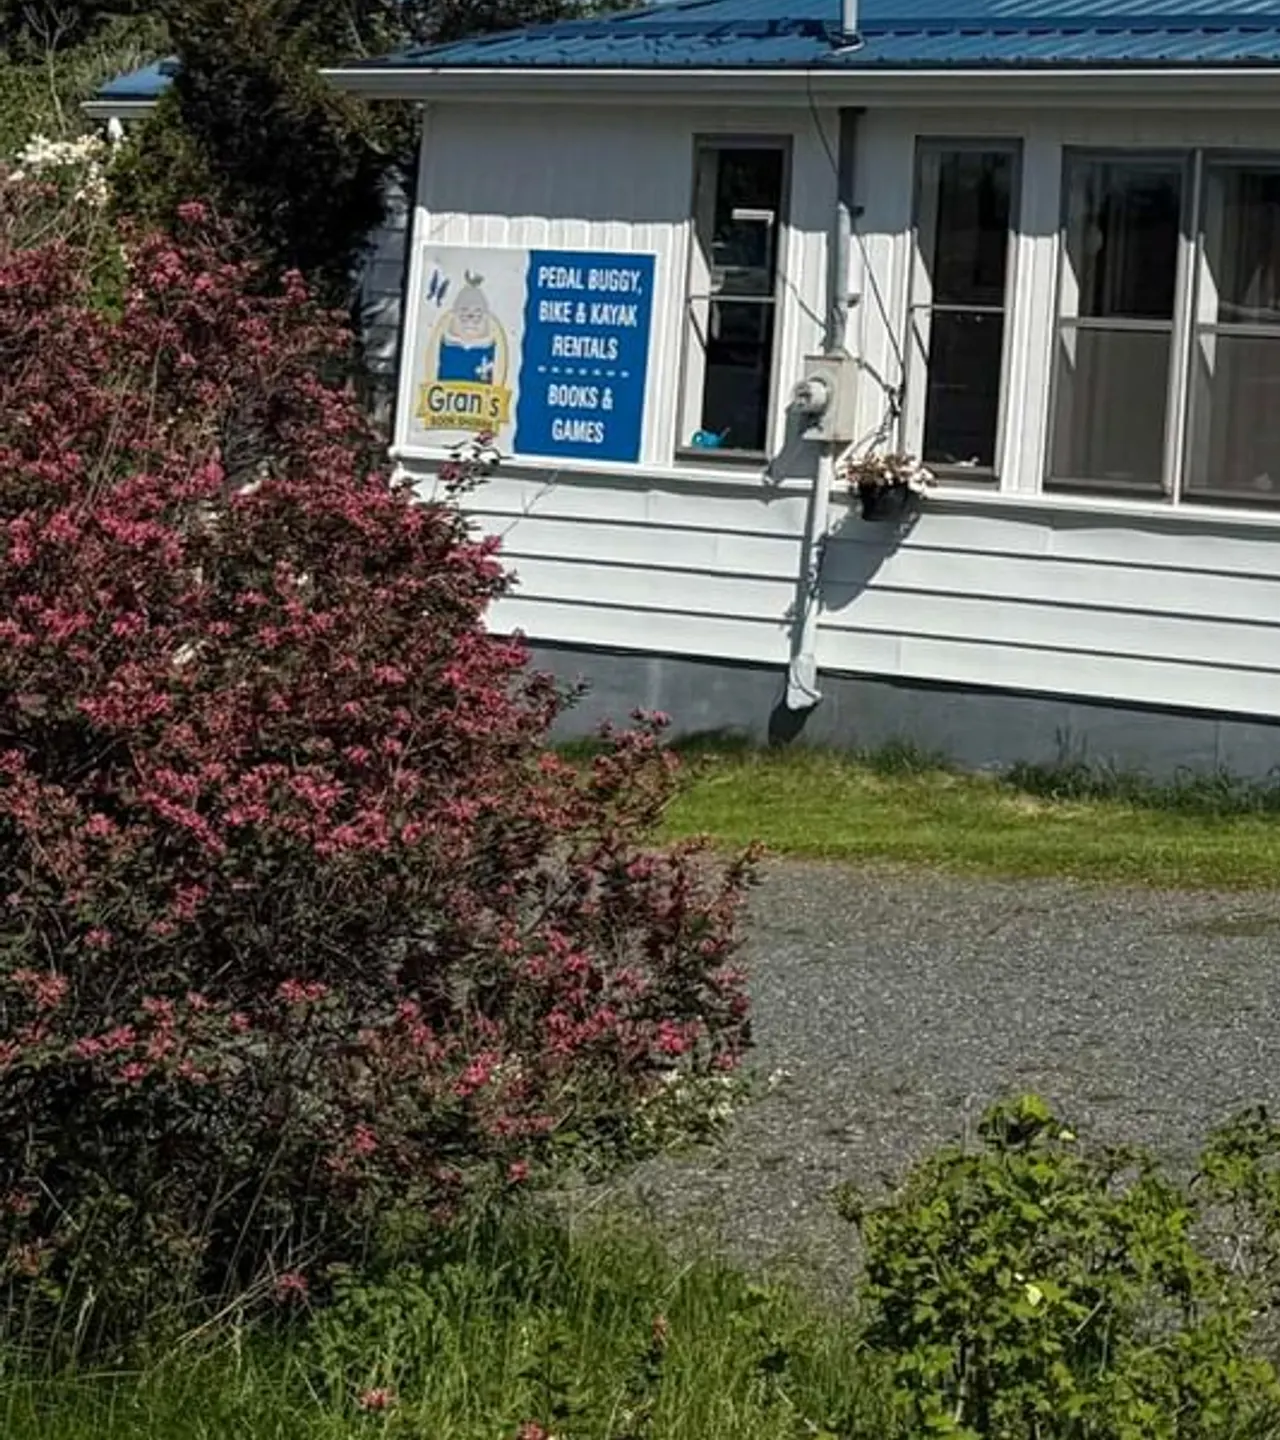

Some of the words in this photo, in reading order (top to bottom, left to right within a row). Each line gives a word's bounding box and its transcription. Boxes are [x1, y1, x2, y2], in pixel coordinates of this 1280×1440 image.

[538, 265, 585, 290] PEDAL
[588, 268, 643, 295] BUGGY,
[539, 300, 572, 324] BIKE
[575, 303, 586, 324] &
[590, 303, 638, 327] KAYAK
[552, 334, 618, 359] RENTALS
[427, 386, 500, 417] Gran's
[547, 384, 599, 409] BOOKS
[602, 388, 613, 410] &
[552, 418, 605, 444] GAMES
